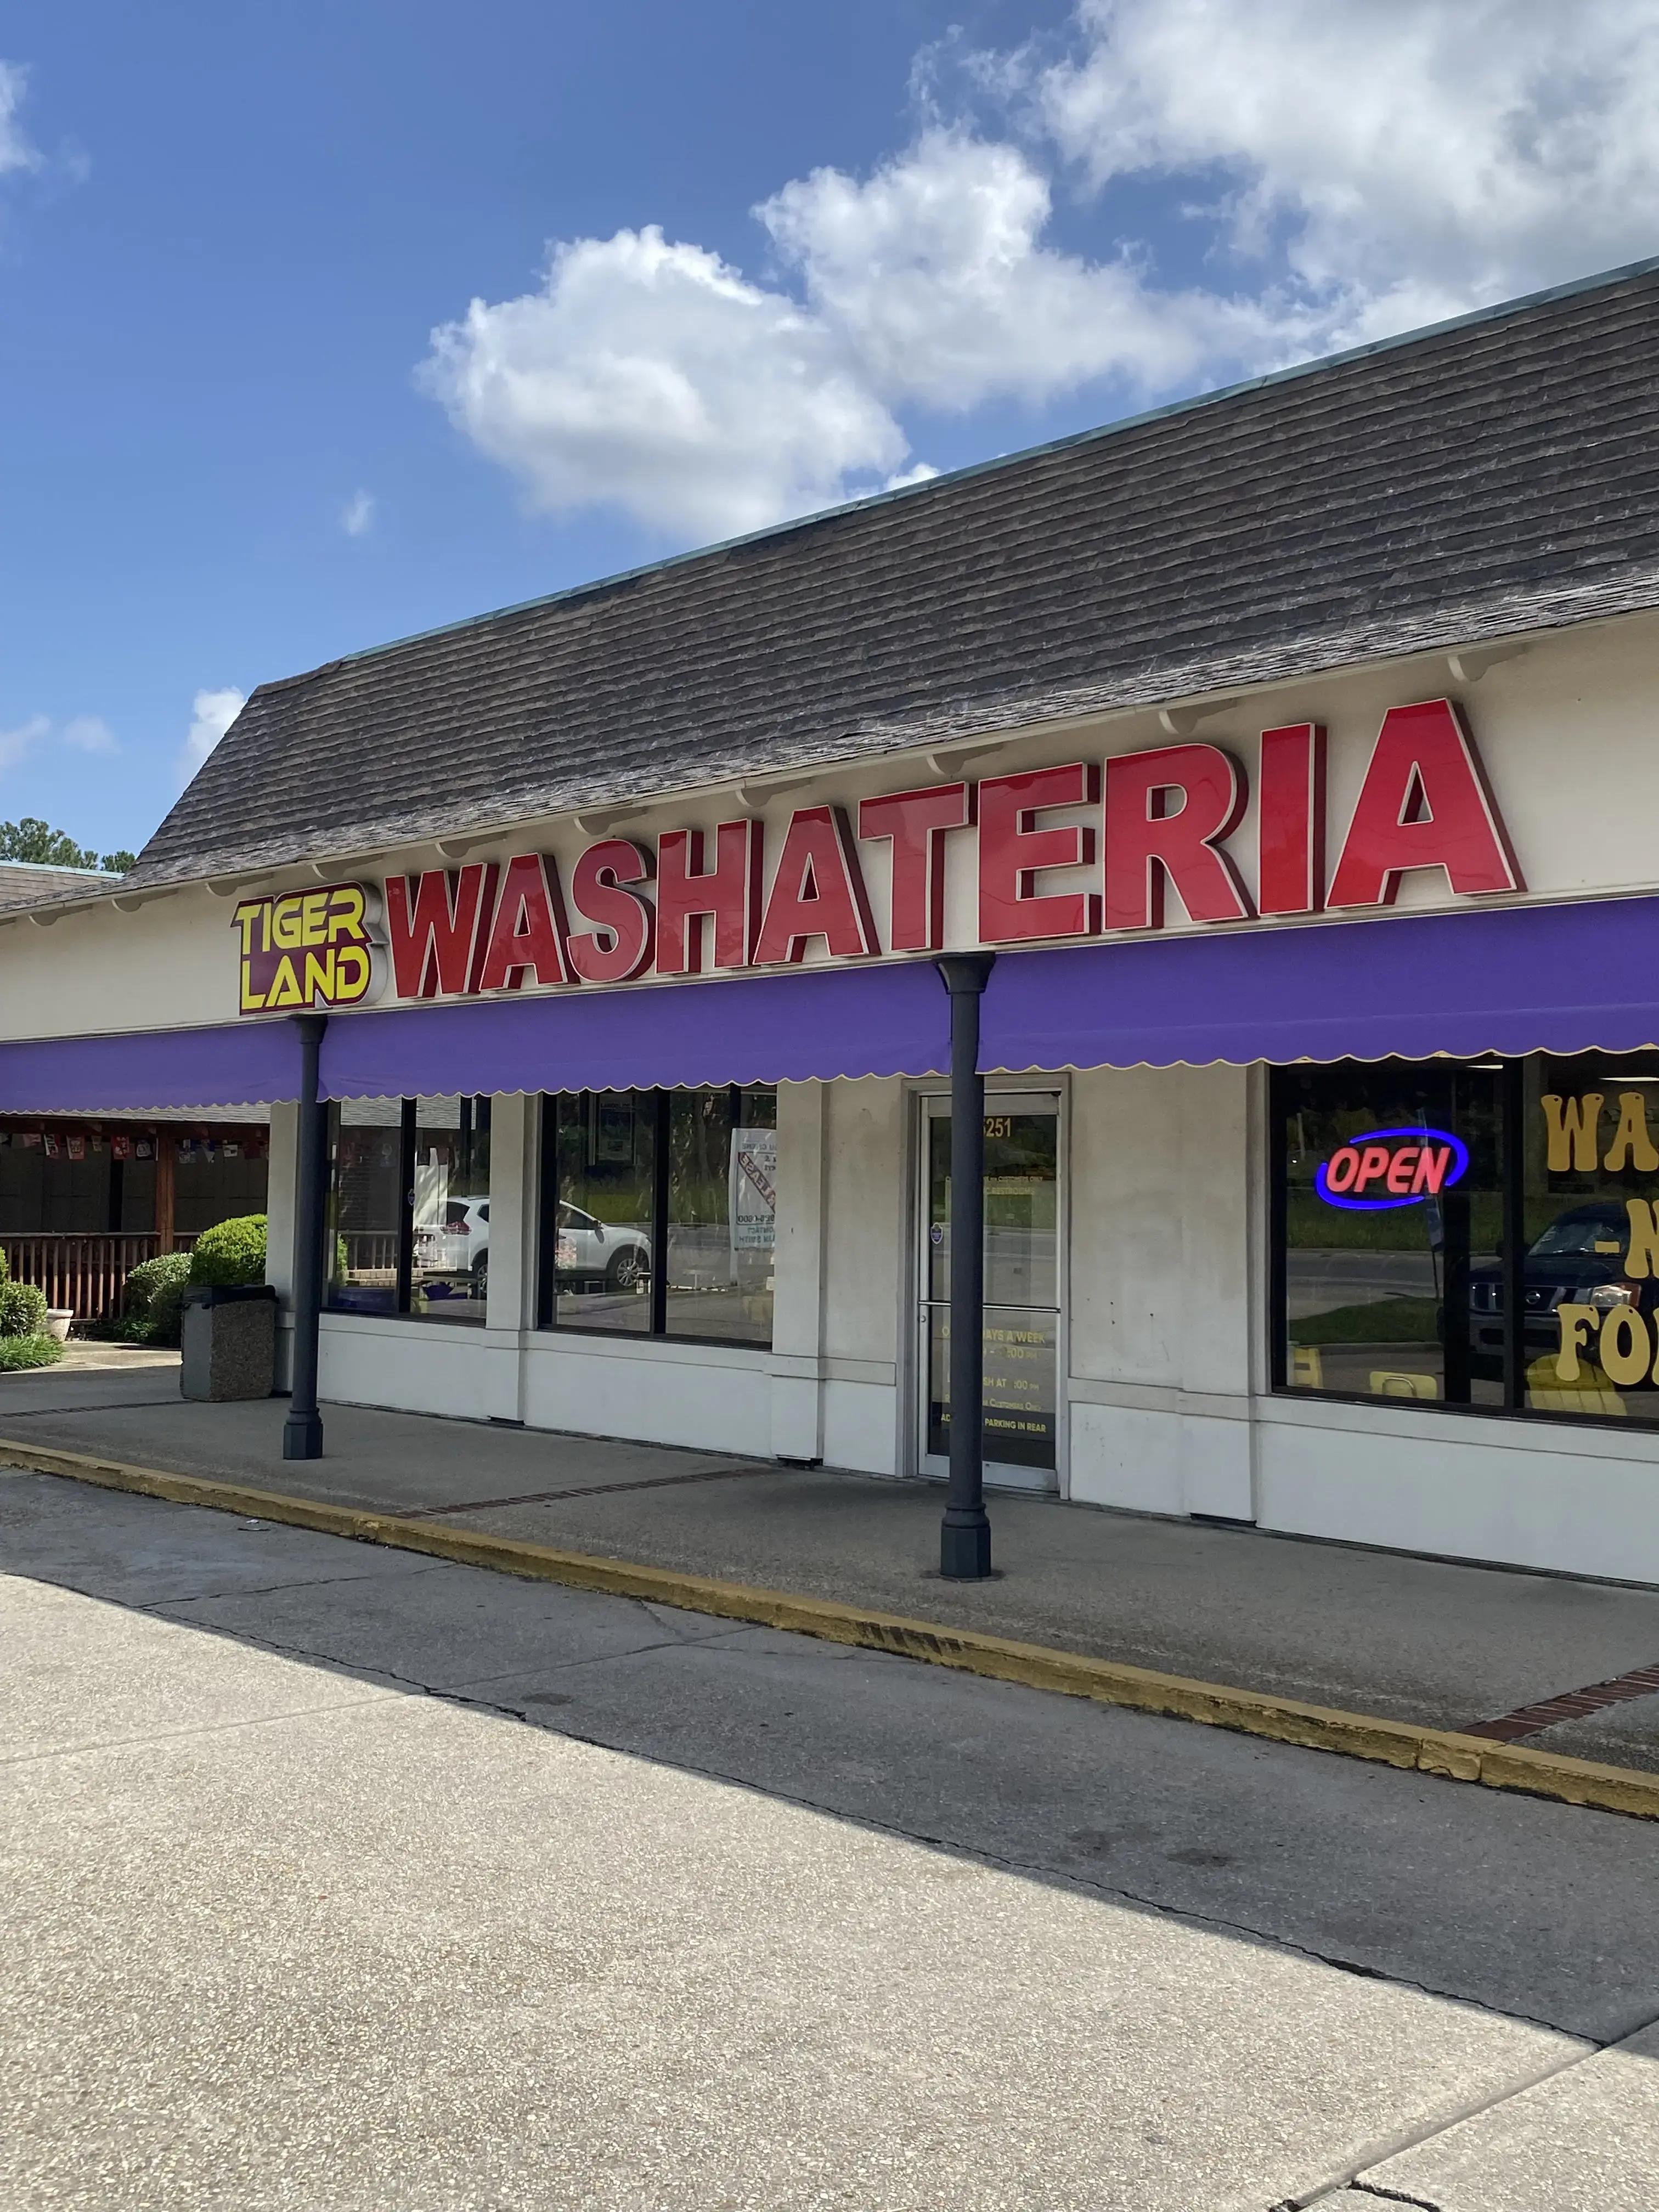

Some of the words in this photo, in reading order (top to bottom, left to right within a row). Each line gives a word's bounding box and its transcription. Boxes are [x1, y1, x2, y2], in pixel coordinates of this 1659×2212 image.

[384, 697, 1524, 999] WASHATERIA
[235, 888, 365, 955] TIGER
[241, 945, 369, 1009] LAND
[983, 1118, 1012, 1137] 251
[1541, 1092, 1659, 1171] WA
[1327, 1147, 1451, 1194] OPEN
[983, 1329, 1004, 1341] AYS
[1016, 1331, 1045, 1344] WEEK
[983, 1376, 994, 1387] SH
[996, 1378, 1007, 1388] AT
[984, 1418, 1017, 1429] PARKING
[1018, 1421, 1025, 1431] IN
[1026, 1422, 1046, 1433] REAR
